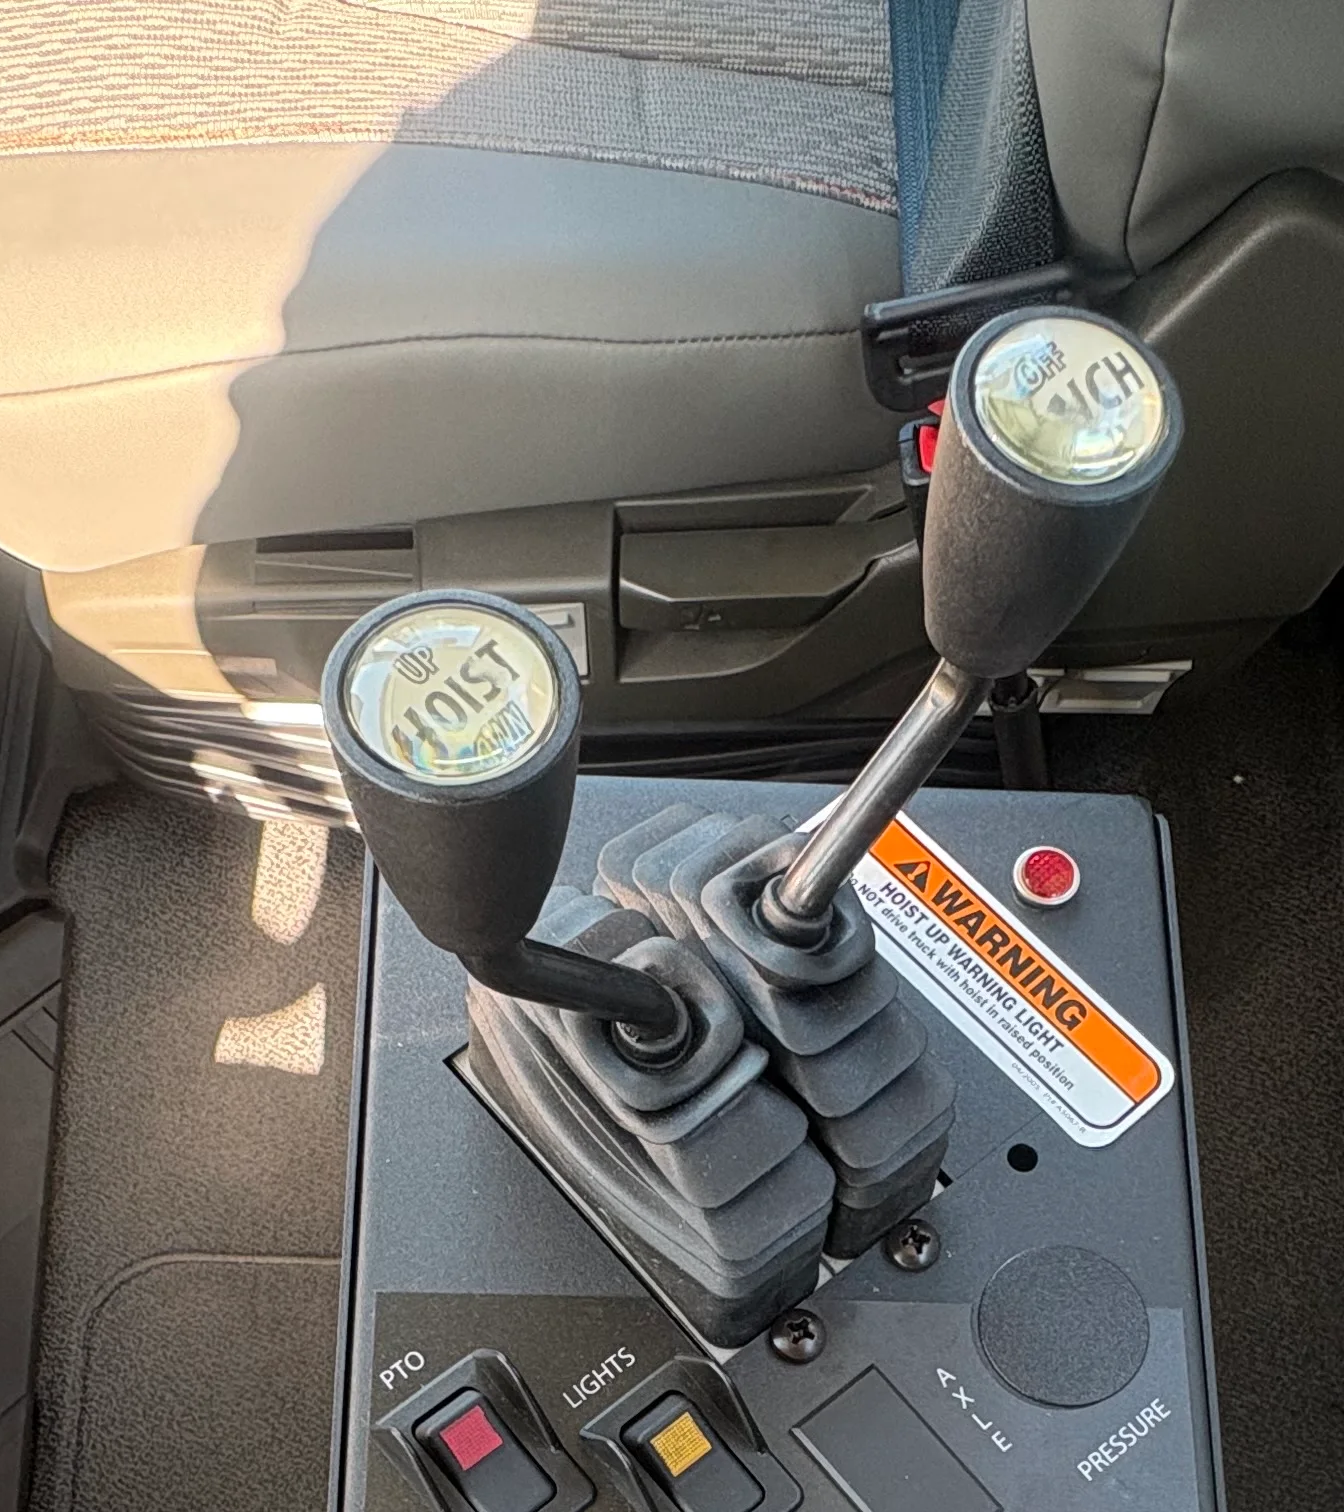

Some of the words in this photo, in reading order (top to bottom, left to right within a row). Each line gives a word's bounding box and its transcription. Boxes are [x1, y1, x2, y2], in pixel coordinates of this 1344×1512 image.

[1013, 341, 1067, 397] OFF
[391, 639, 520, 766] HOIST
[393, 646, 440, 685] UP
[859, 883, 885, 909] NOT
[881, 904, 908, 934] drive
[907, 929, 937, 961] truck
[936, 958, 962, 984] with
[958, 977, 989, 1010] hoist
[986, 1006, 999, 1019] in
[996, 1015, 1033, 1049] raised
[1029, 1048, 1074, 1092] position
[880, 881, 930, 925] HOIST
[928, 923, 951, 946] UP
[948, 943, 1022, 1013] WARNING
[1015, 1002, 1064, 1054] LIGHT
[932, 880, 1088, 1032] WARNING
[379, 1350, 425, 1390] PTO
[562, 1346, 636, 1409] LIGHTS
[936, 1367, 1013, 1453] AXLE
[1076, 1397, 1172, 1481] PRESSURE
